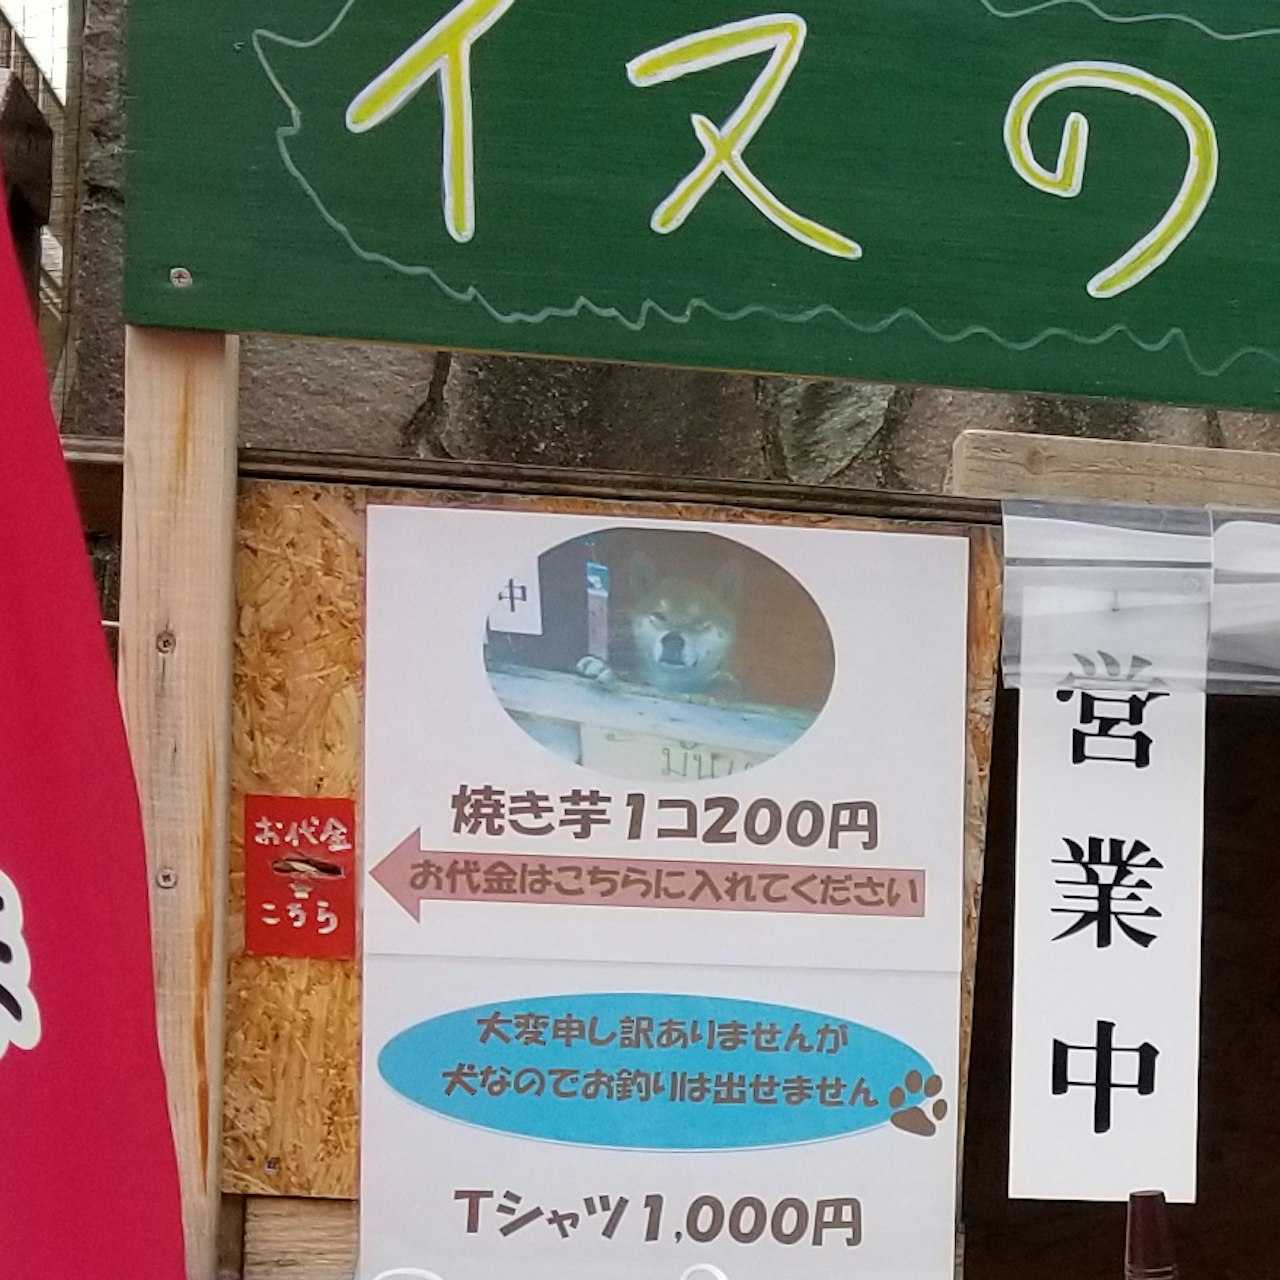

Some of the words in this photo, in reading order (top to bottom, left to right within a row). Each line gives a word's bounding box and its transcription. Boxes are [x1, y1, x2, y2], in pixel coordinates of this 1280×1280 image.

[498, 578, 527, 613] 中
[254, 815, 352, 852] お代金
[409, 858, 919, 909] お代金はこちらに入れてください
[1050, 650, 1170, 1135] 営業中
[261, 899, 339, 935] こちら
[476, 1011, 849, 1055] 大変申し訳ありませんが
[441, 1063, 880, 1107] 犬なのでお釣りは出せません
[453, 1190, 863, 1247] Tシャツ1,000円
